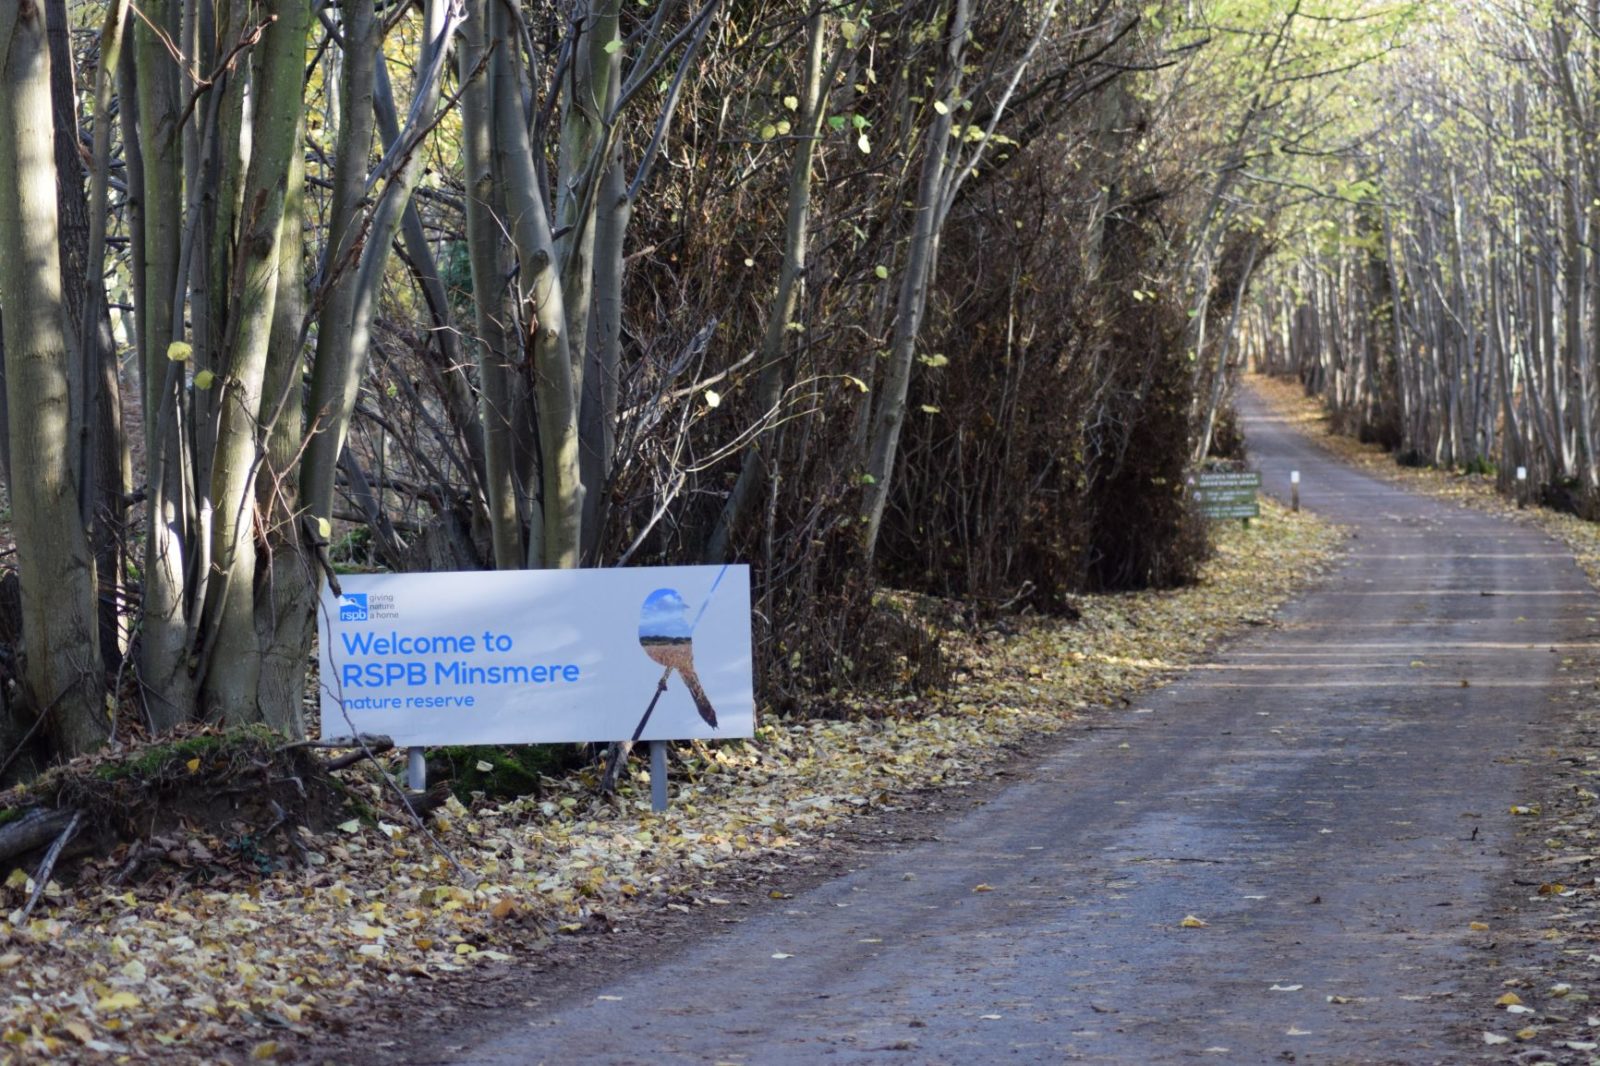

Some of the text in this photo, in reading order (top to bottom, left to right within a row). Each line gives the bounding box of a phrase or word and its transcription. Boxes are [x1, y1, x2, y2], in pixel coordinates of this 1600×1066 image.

[369, 593, 393, 603] giving
[341, 609, 366, 620] rspb
[376, 611, 399, 619] home
[341, 631, 513, 656] Welcome to
[342, 661, 580, 688] RSPB Minsmere
[343, 694, 475, 710] nature reserve
